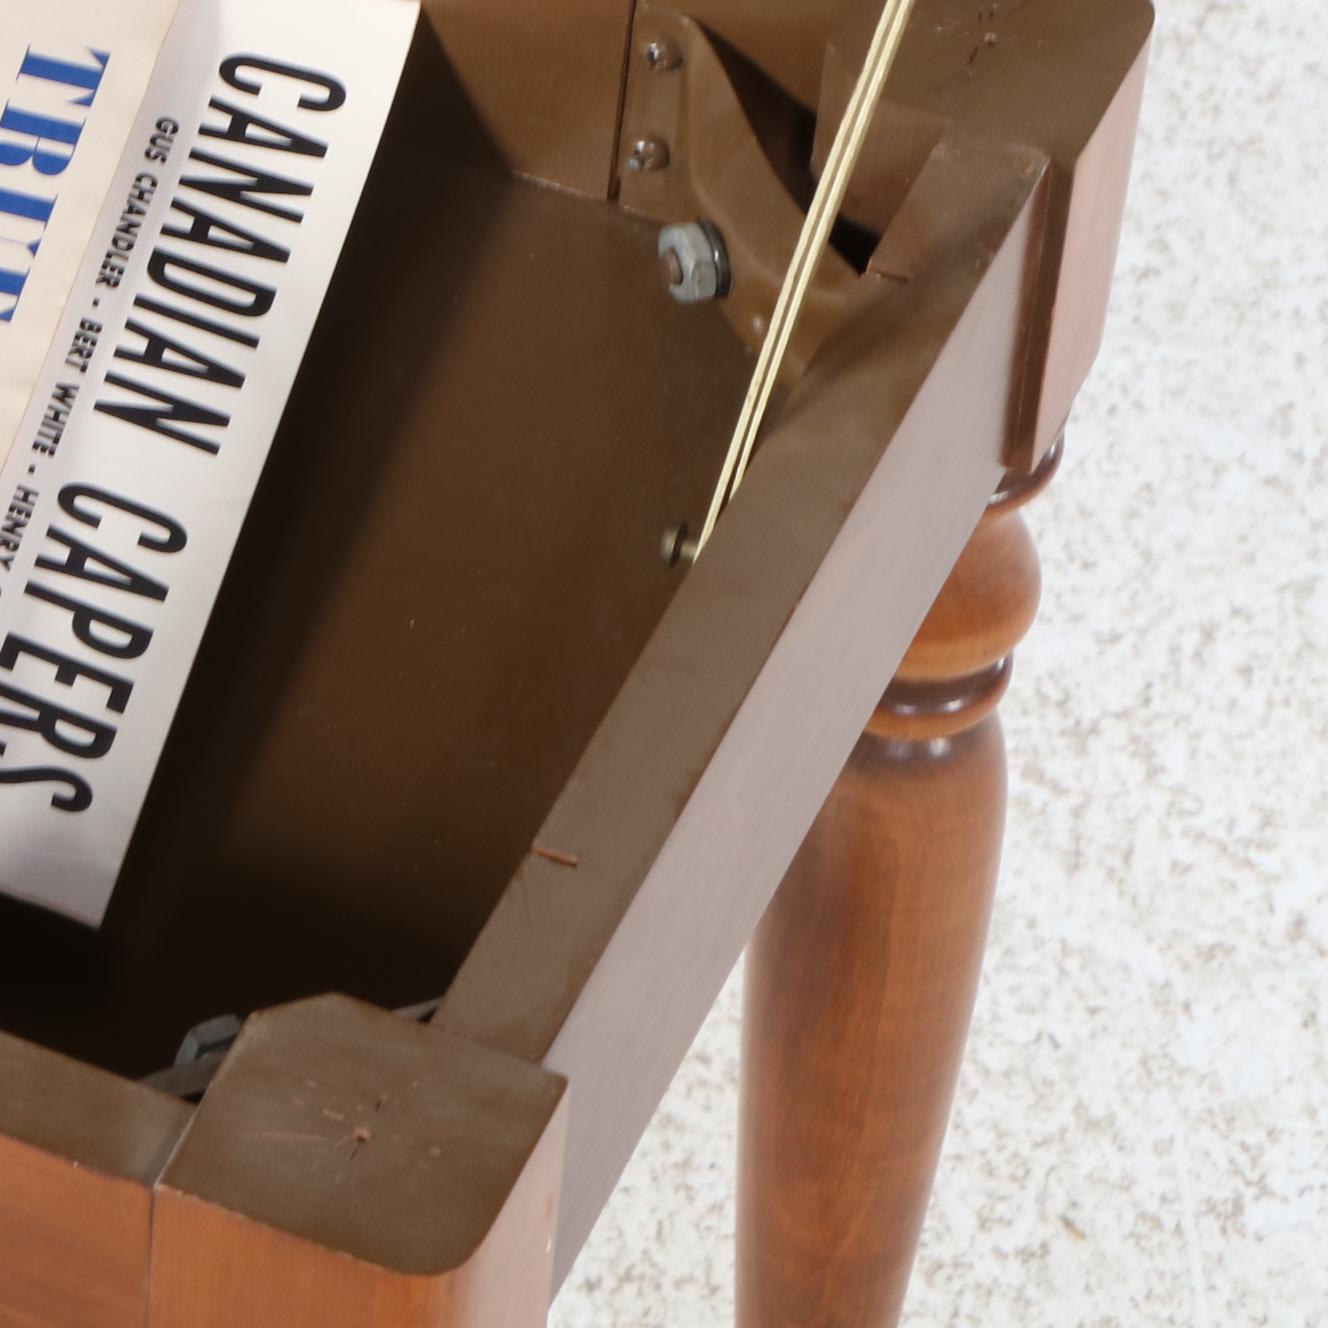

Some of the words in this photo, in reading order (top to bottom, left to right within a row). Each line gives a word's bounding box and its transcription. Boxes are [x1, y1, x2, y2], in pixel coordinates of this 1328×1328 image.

[142, 116, 179, 165] GUS
[92, 171, 158, 288] CHANDLER
[92, 50, 347, 457] CANADIAN
[65, 317, 104, 374] BERT
[31, 382, 81, 460] WHITE
